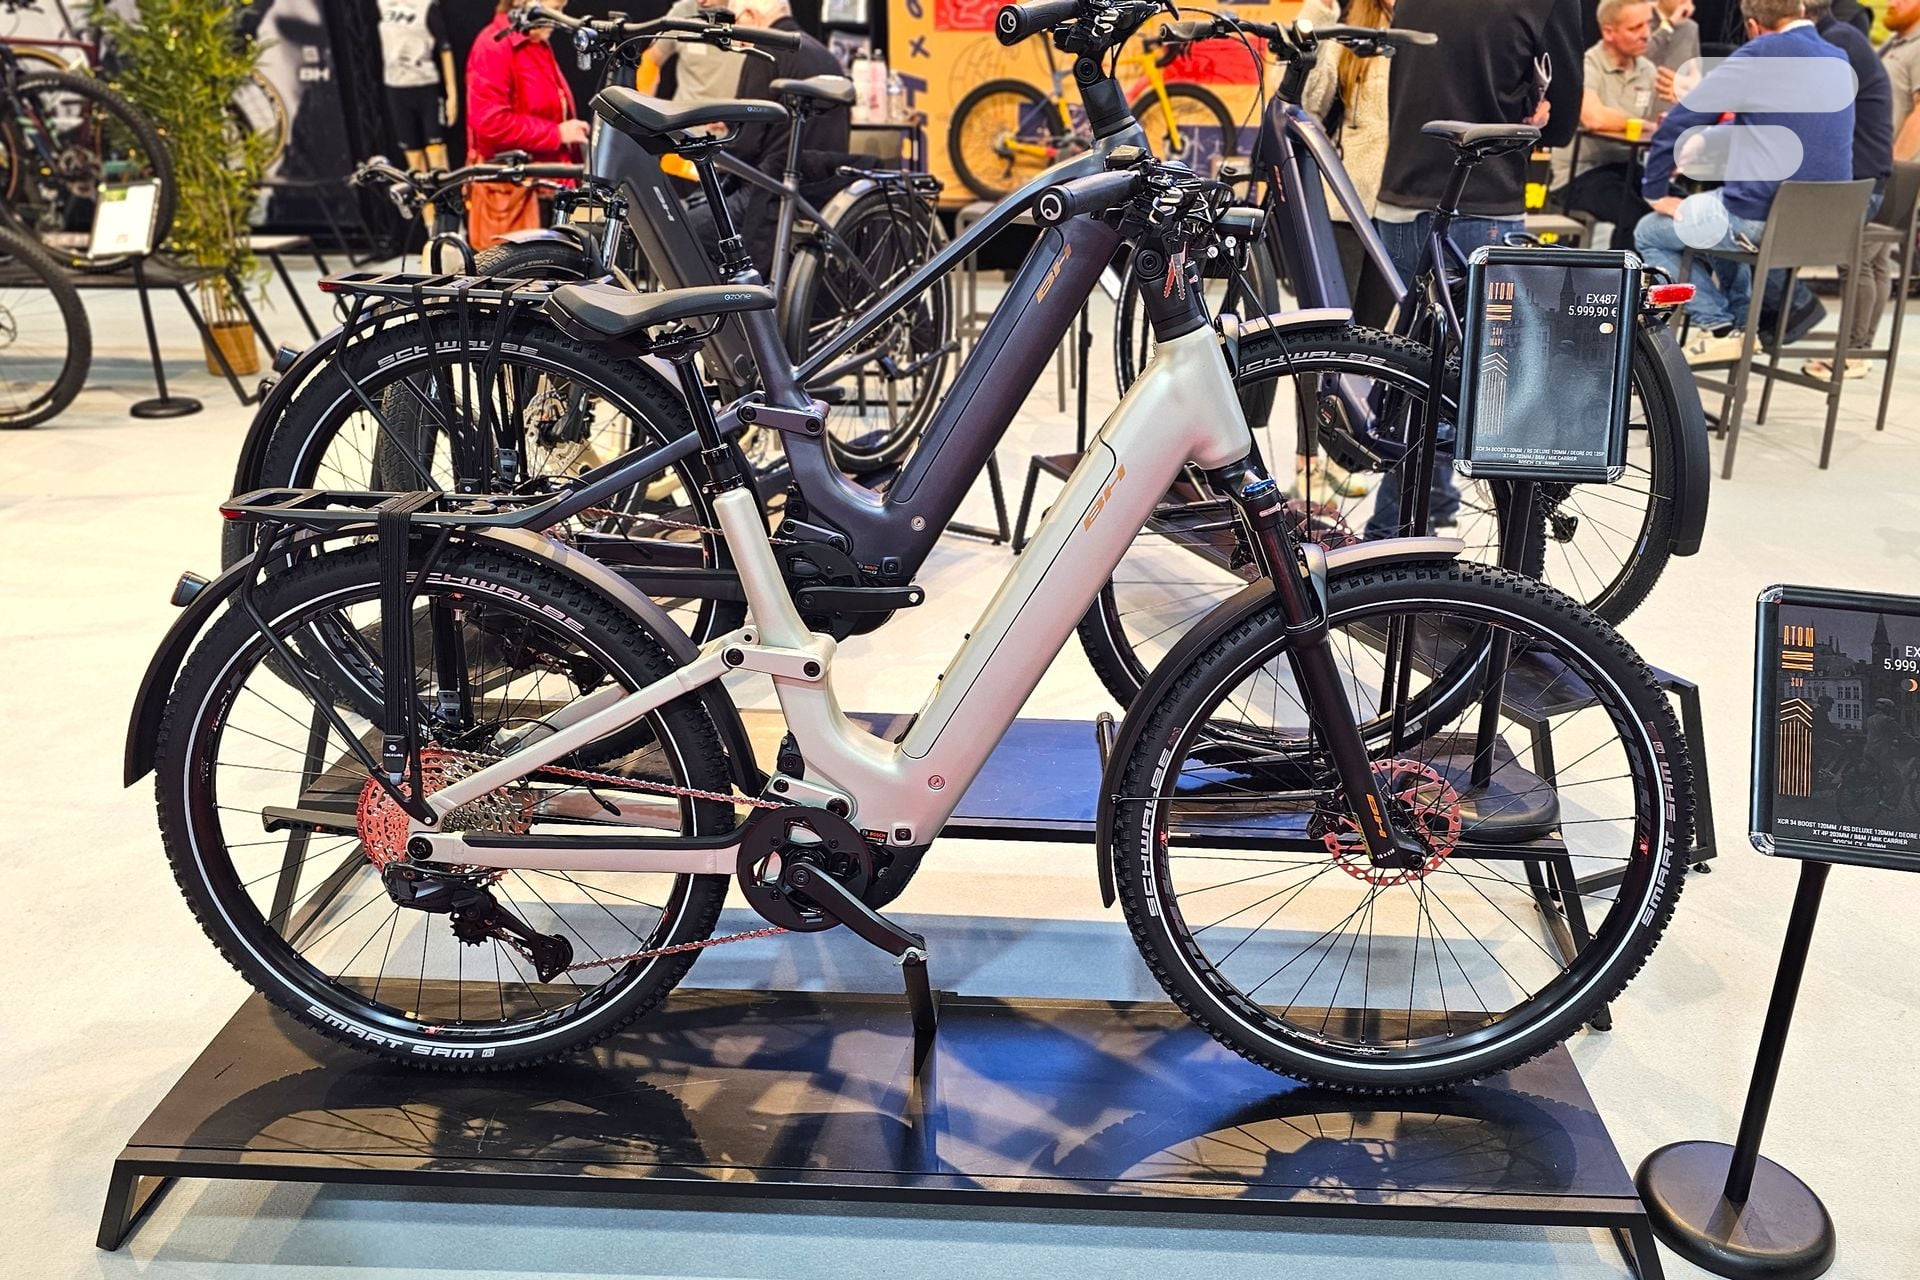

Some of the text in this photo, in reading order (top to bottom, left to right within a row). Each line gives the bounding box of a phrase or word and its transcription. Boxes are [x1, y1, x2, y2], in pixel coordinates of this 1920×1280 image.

[1036, 243, 1072, 304] BH
[1488, 282, 1514, 300] ATOM
[1586, 294, 1617, 304] EX487
[1568, 305, 1618, 318] 5.999,90 €
[1083, 463, 1126, 532] BH
[1783, 625, 1814, 647] ATOM
[1883, 658, 1920, 674] 5.999,
[1366, 794, 1388, 838] BH
[1140, 748, 1171, 917] SCHWALBE
[1798, 820, 1816, 828] BOOST
[1818, 822, 1836, 830] 120MM
[1852, 826, 1873, 834] DELUXE
[1874, 828, 1894, 836] 120MM
[1898, 831, 1918, 840] DEORE
[1882, 837, 1908, 845] CARRIER
[1641, 760, 1677, 928] SMART SAM
[306, 1004, 475, 1059] SMART SAM
